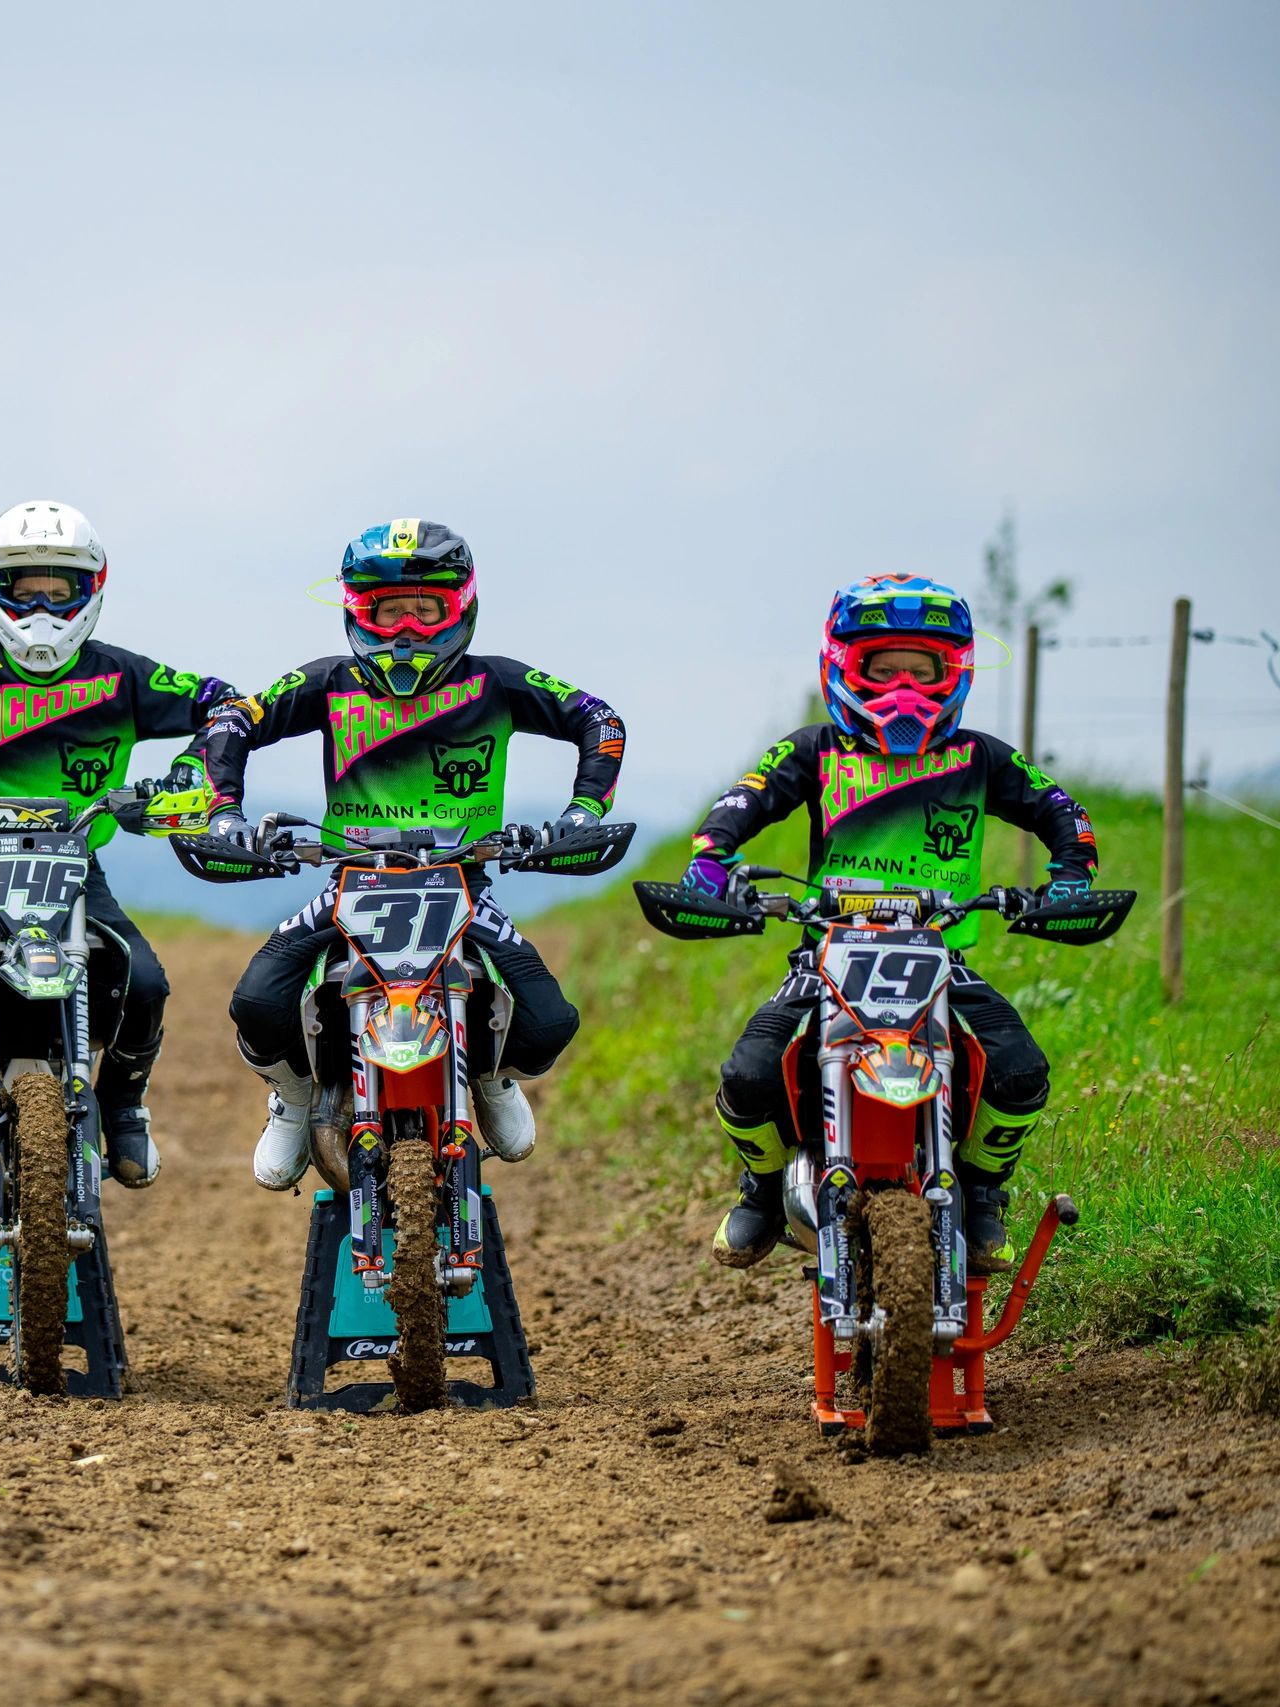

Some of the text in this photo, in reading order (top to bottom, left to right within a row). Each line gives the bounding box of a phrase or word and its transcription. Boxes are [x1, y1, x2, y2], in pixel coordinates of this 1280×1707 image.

[327, 672, 487, 783] RACCOON
[819, 740, 976, 838] RACCOON
[433, 803, 497, 821] Gruppe
[206, 860, 253, 874] CIRCUIT
[552, 851, 600, 866] CIRCUIT
[828, 853, 904, 875] FMANN
[359, 873, 377, 881] Esch
[349, 891, 461, 954] 31
[676, 912, 729, 929] CIRCUIT
[1045, 917, 1098, 931] CIRCUIT
[841, 950, 943, 1002] 19
[75, 1123, 85, 1202] HOFMANN Gruppe
[352, 1190, 360, 1211] GATRA
[370, 1174, 380, 1246] FMANN Gruppe
[453, 1201, 461, 1246] HOFMANN
[470, 1219, 478, 1240] GATRA
[939, 1210, 950, 1244] Gruppe
[839, 1265, 850, 1300] Gruppe
[364, 1295, 378, 1303] Oil
